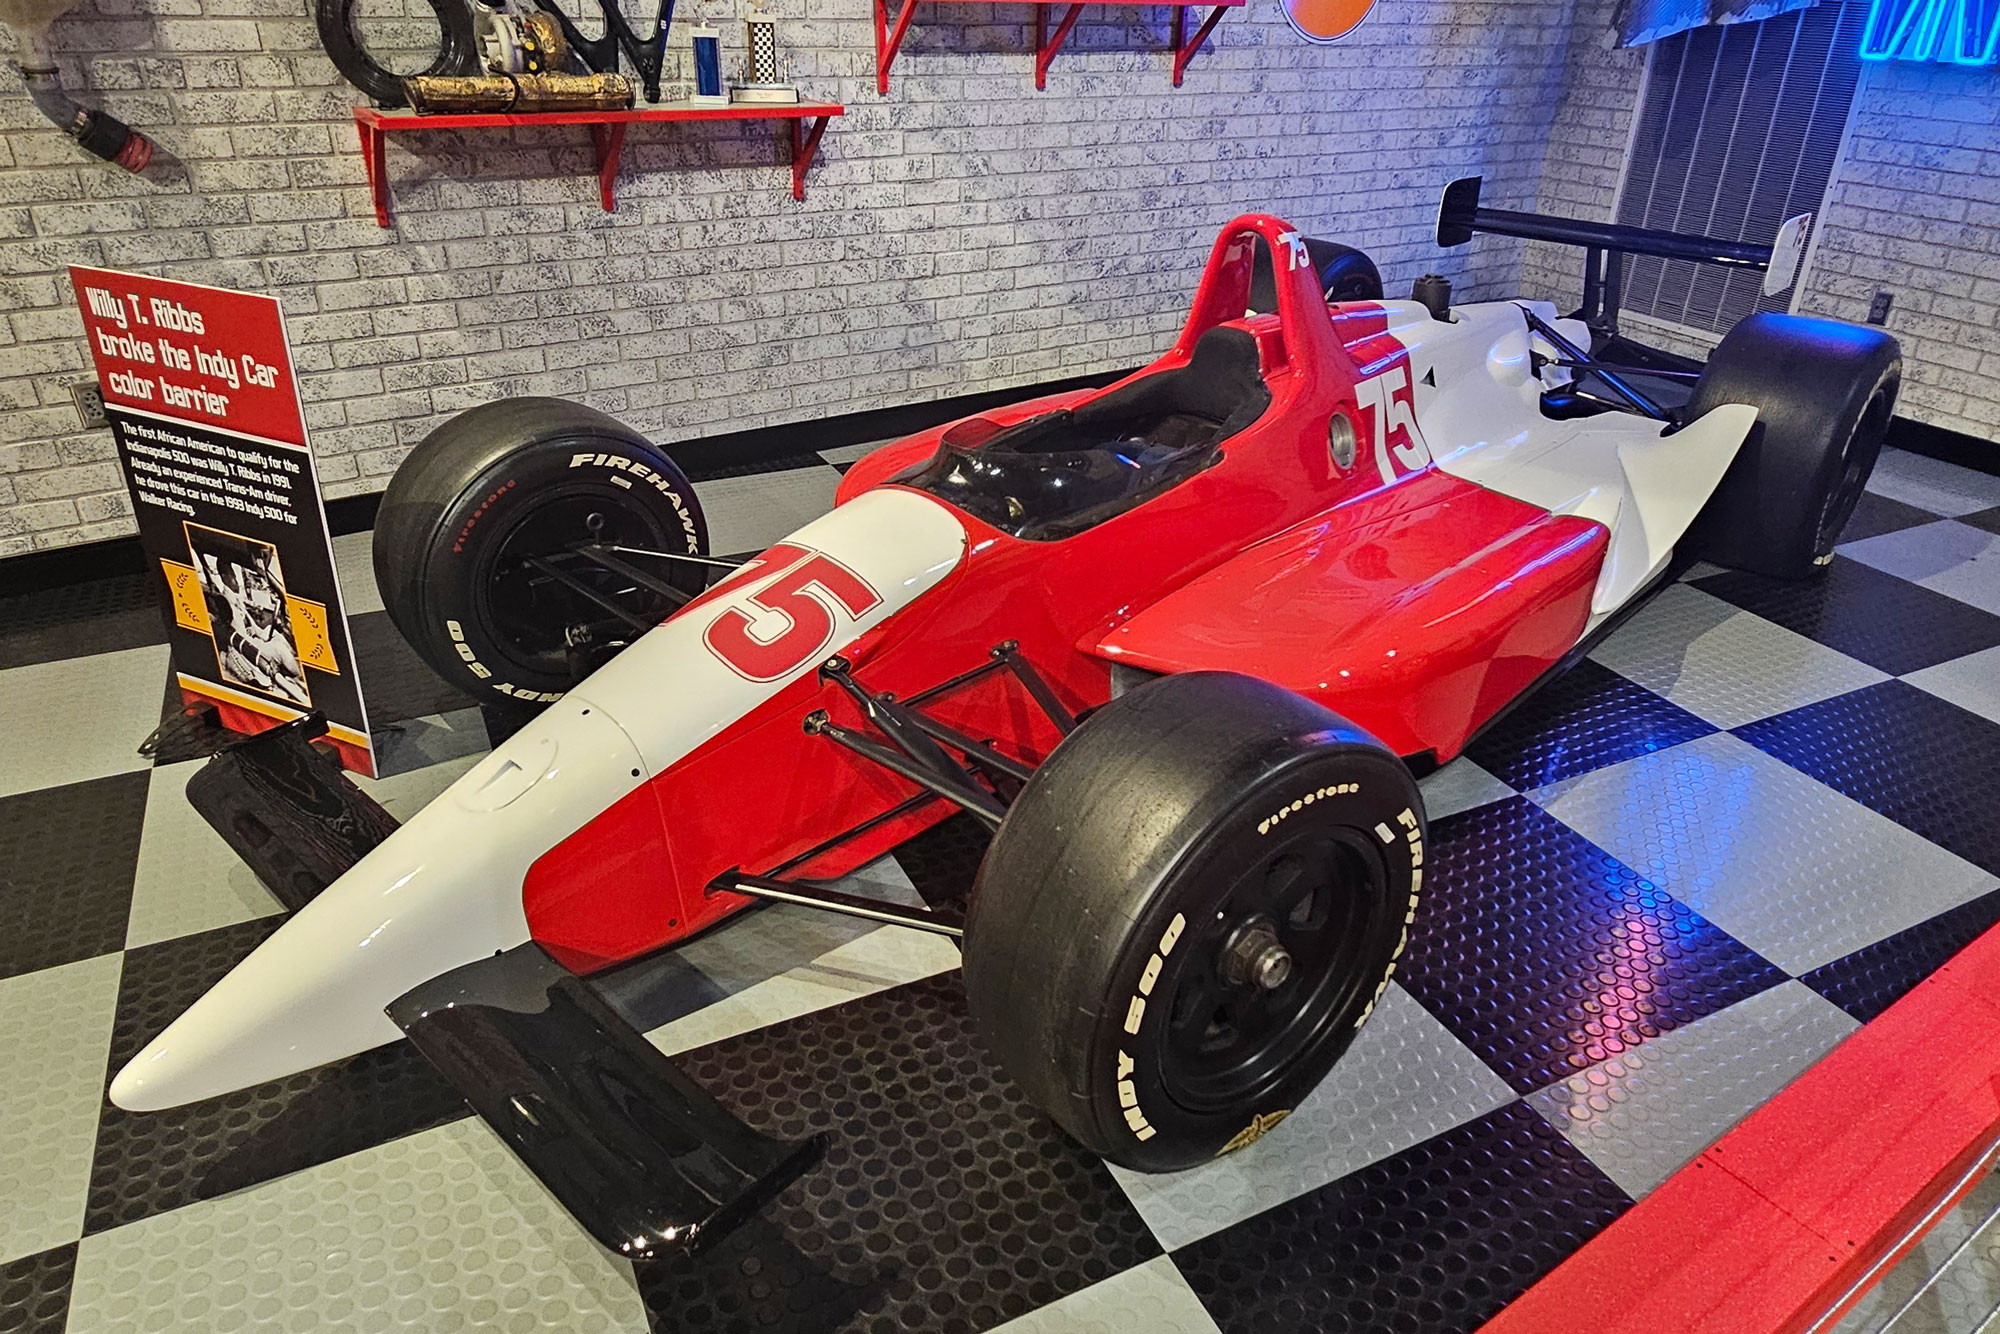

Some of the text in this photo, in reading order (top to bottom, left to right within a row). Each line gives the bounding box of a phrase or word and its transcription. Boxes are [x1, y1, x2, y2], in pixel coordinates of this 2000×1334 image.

[1277, 231, 1311, 271] 75
[85, 286, 205, 335] Willy T. Ribbs
[96, 327, 279, 389] broke the Indy Car
[108, 370, 229, 417] color barrier
[120, 421, 300, 474] The first African American to qualify for the
[1354, 366, 1431, 485] 75
[125, 439, 172, 461] Indianapolis
[172, 450, 190, 464] 500
[190, 457, 208, 468] was
[208, 458, 229, 477] Willy
[229, 463, 237, 476] T.
[237, 466, 262, 482] Ribbs
[262, 471, 271, 484] in
[131, 457, 162, 476] Already
[162, 465, 172, 476] an
[173, 467, 223, 489] experienced
[223, 479, 264, 500] Trans-Am
[134, 473, 298, 525] he drove this car in the 1993 Indy 500 for
[138, 490, 166, 508] Walker
[453, 479, 517, 553] Firestone
[569, 453, 699, 555] FIREHAWK
[446, 620, 566, 702] NDY 500
[1257, 783, 1359, 835] Firestone
[1117, 912, 1186, 1142] INDY 500
